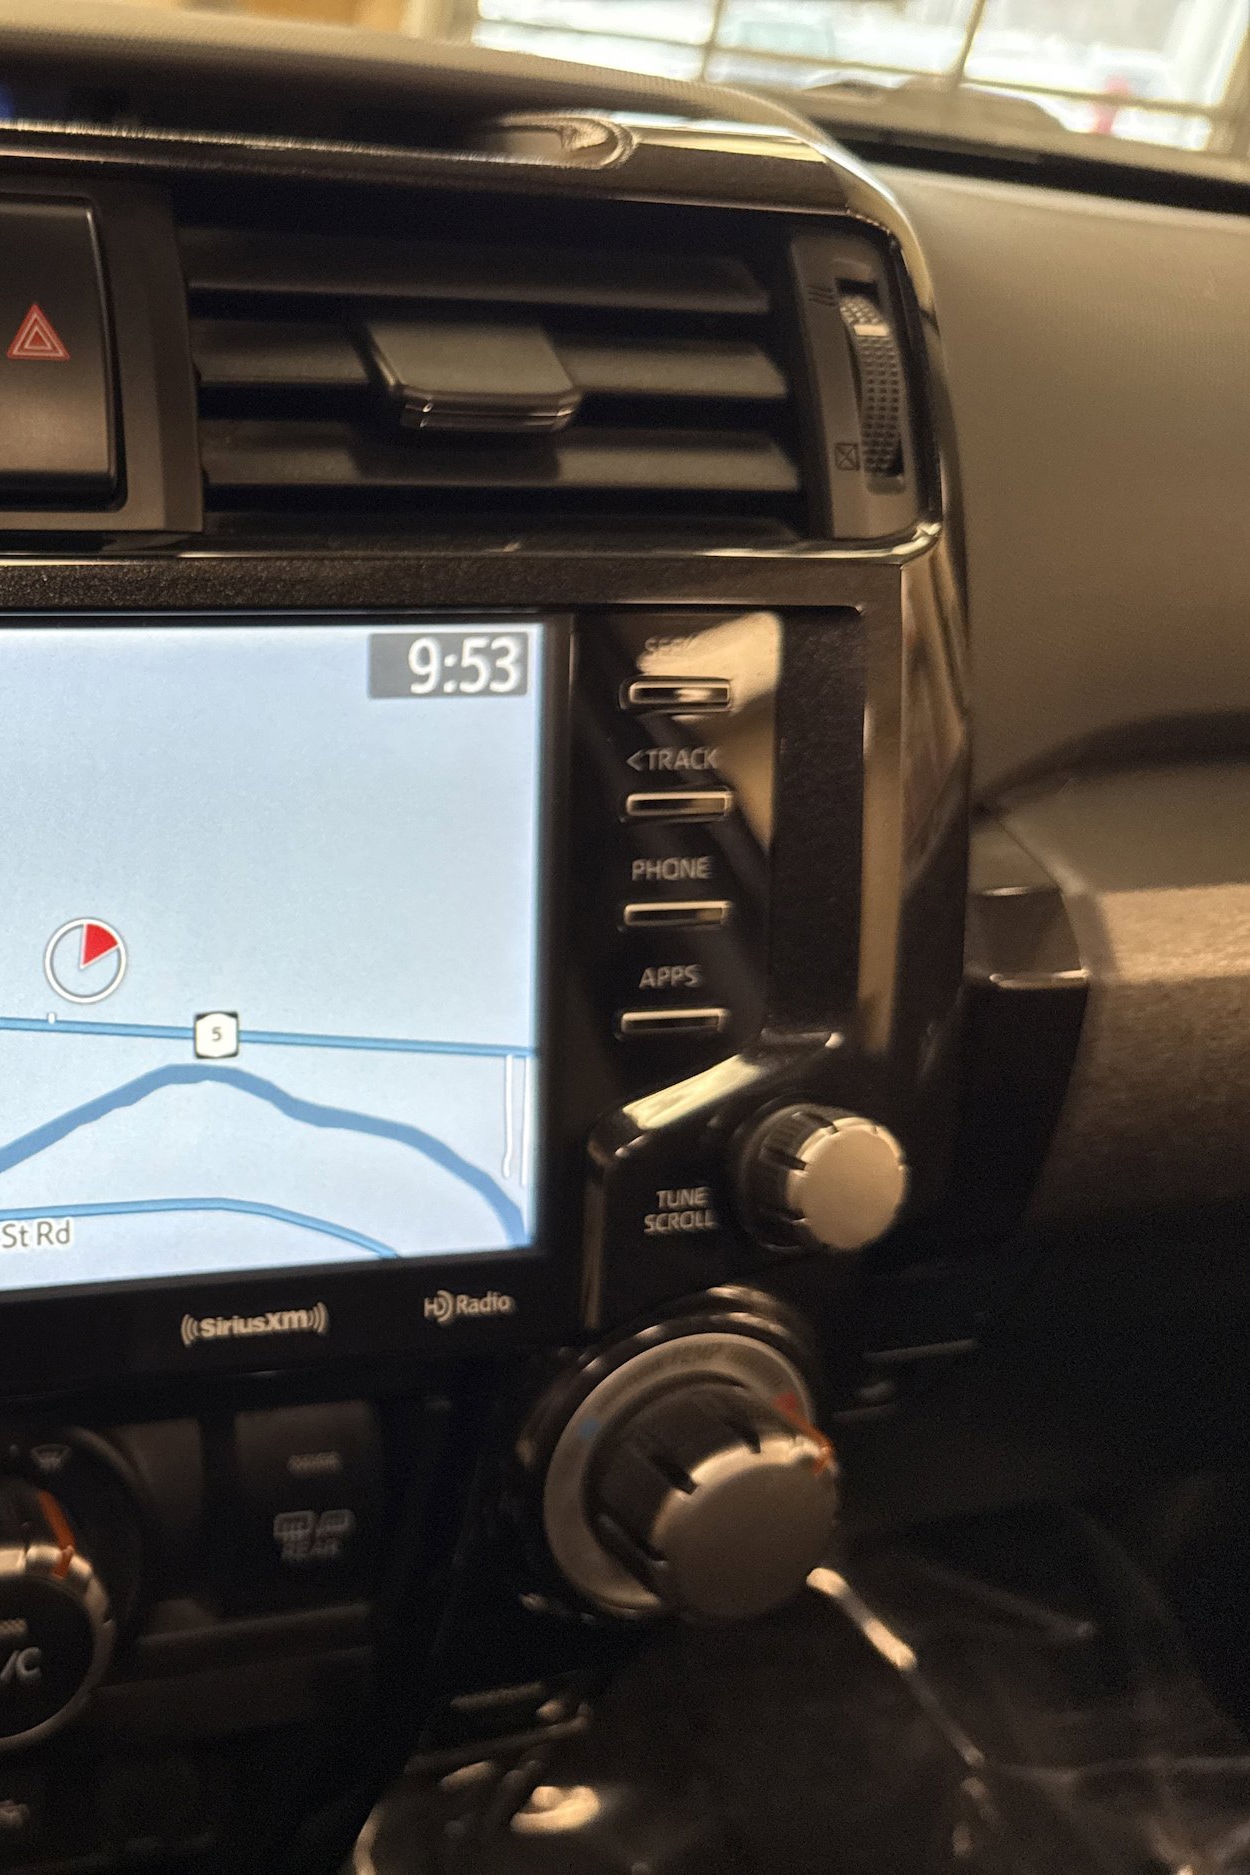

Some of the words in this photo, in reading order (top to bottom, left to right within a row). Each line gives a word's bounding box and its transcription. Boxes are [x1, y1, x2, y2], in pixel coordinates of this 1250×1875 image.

[408, 636, 522, 694] 9:53
[631, 856, 714, 881] PHONE
[639, 963, 701, 990] APPS
[211, 1026, 223, 1042] 5
[656, 1186, 710, 1209] TUNE
[2, 1223, 29, 1249] St
[36, 1219, 71, 1246] Rd
[643, 1209, 718, 1234] SCROLL
[456, 1291, 515, 1317] Radio
